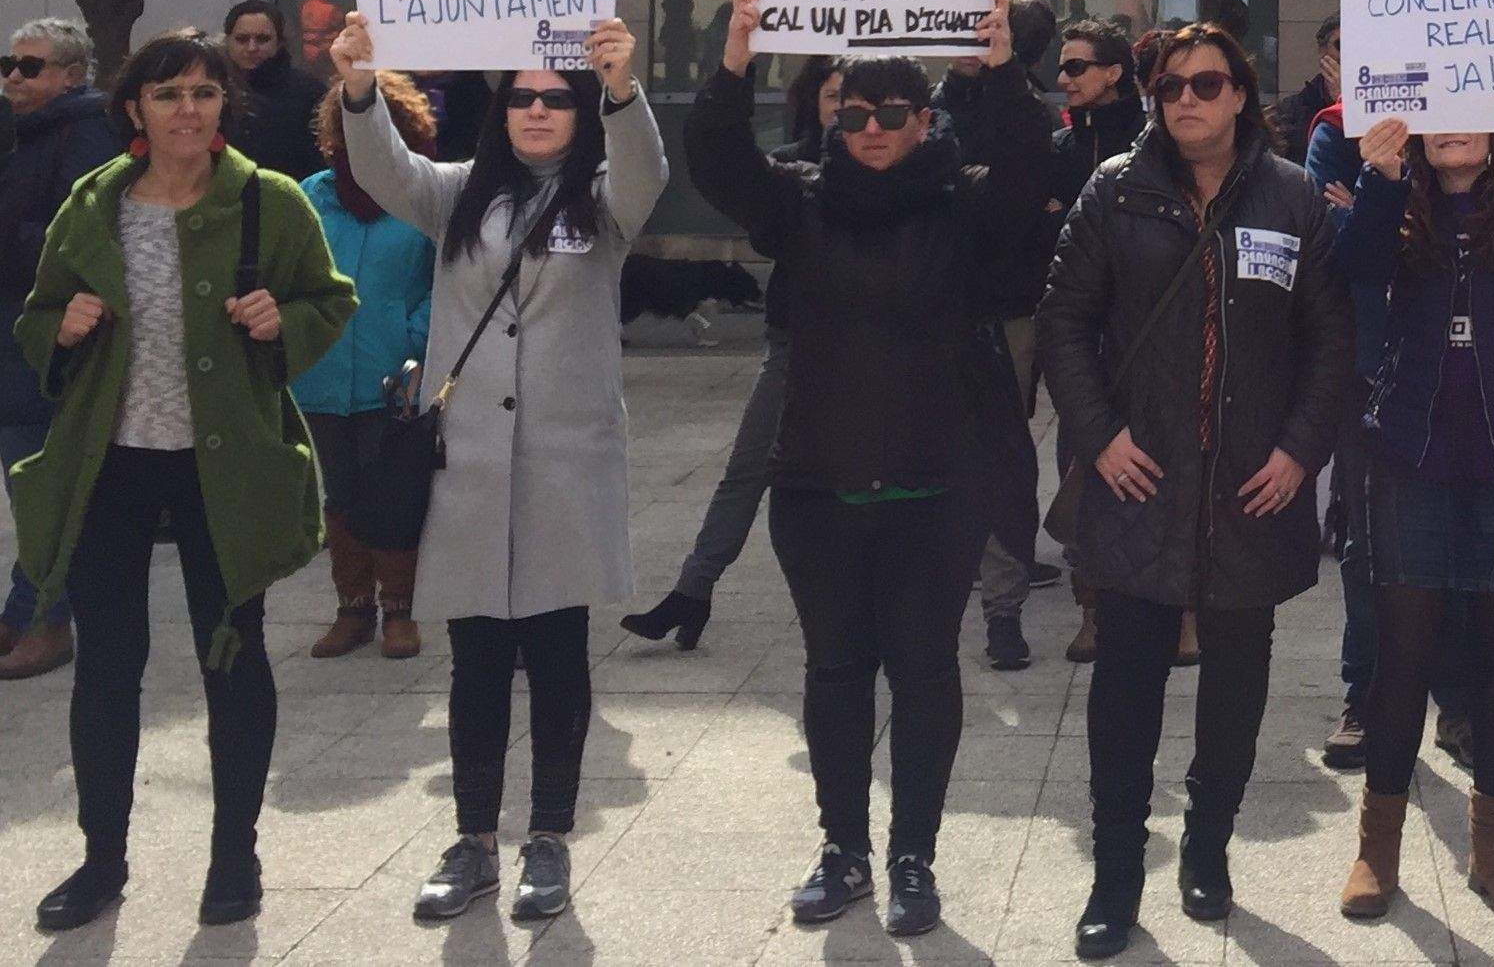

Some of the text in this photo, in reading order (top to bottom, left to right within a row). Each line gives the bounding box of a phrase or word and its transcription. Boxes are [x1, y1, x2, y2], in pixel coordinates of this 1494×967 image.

[537, 19, 551, 40] 8
[760, 6, 804, 31] CAL
[810, 7, 846, 35] UN
[855, 8, 893, 35] PLA
[1359, 66, 1371, 84] 8
[1240, 231, 1252, 248] 8
